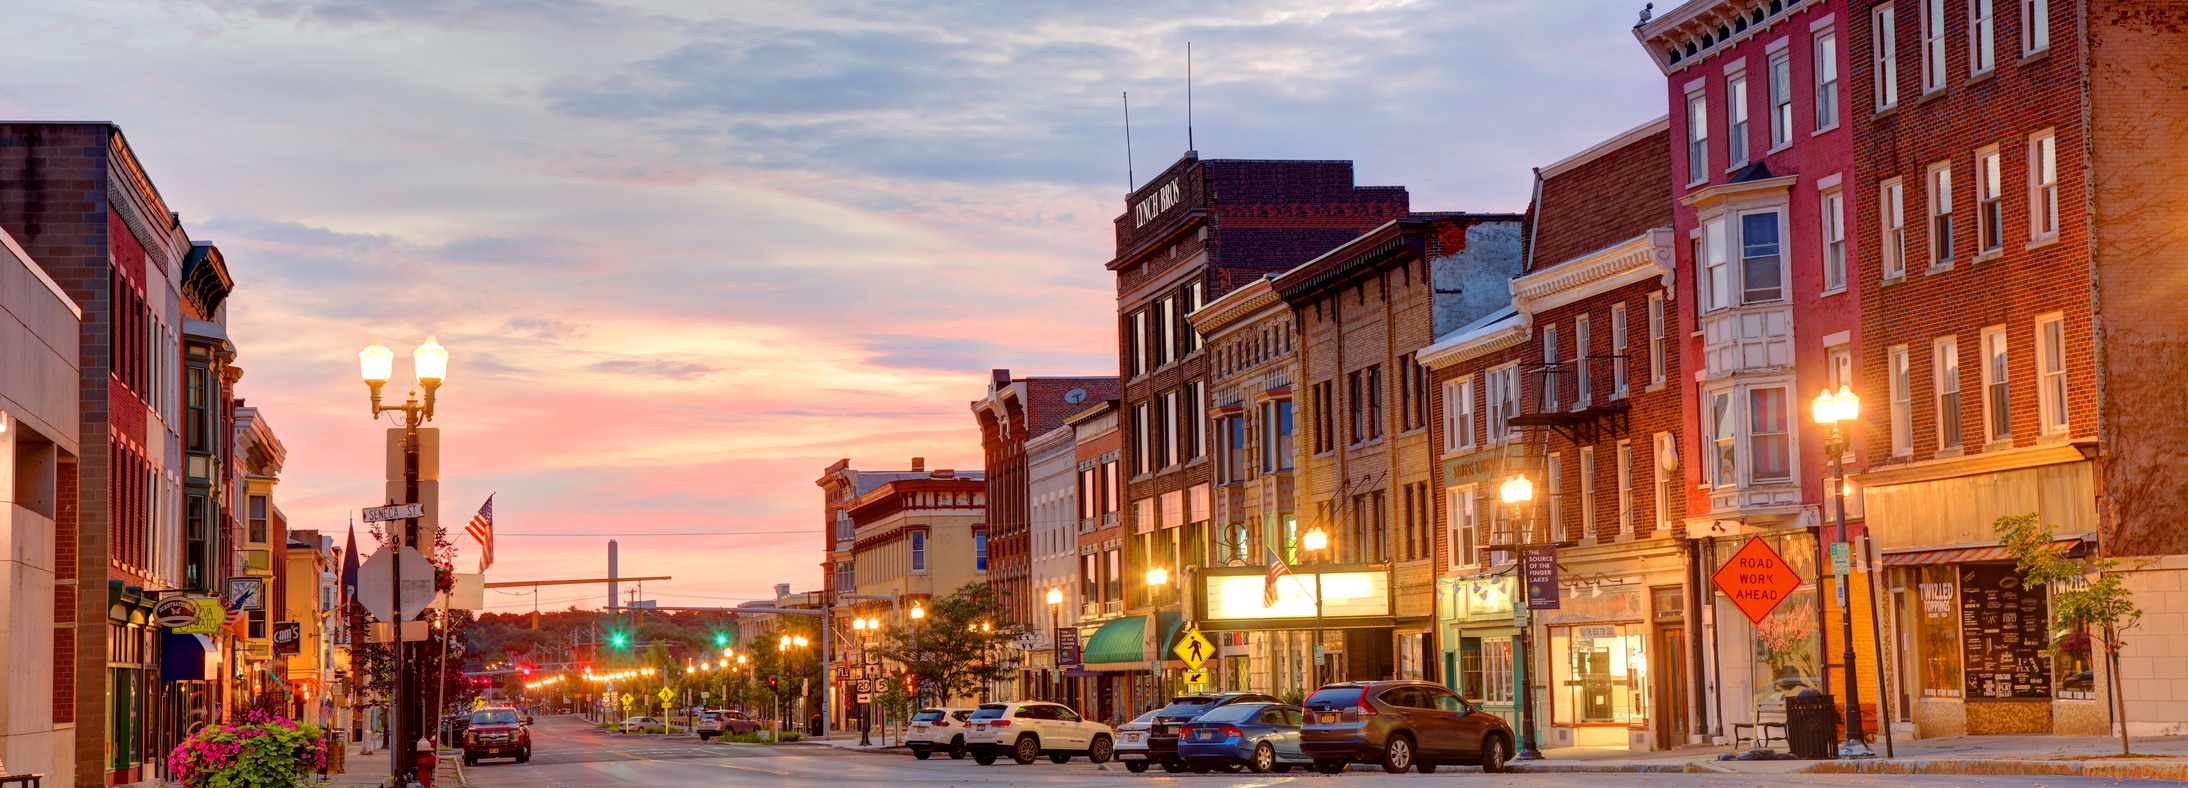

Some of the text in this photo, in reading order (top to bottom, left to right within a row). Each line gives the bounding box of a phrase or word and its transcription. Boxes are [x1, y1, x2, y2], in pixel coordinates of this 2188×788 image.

[1136, 177, 1180, 229] LYNCH BROS
[369, 504, 419, 520] SENECA ST.
[1740, 558, 1773, 568] ROAD
[1740, 574, 1774, 584] WORK
[1736, 589, 1778, 600] AHEAD
[1924, 600, 1950, 613] TOPPINGS
[858, 682, 869, 690] 20
[880, 681, 885, 690] 5
